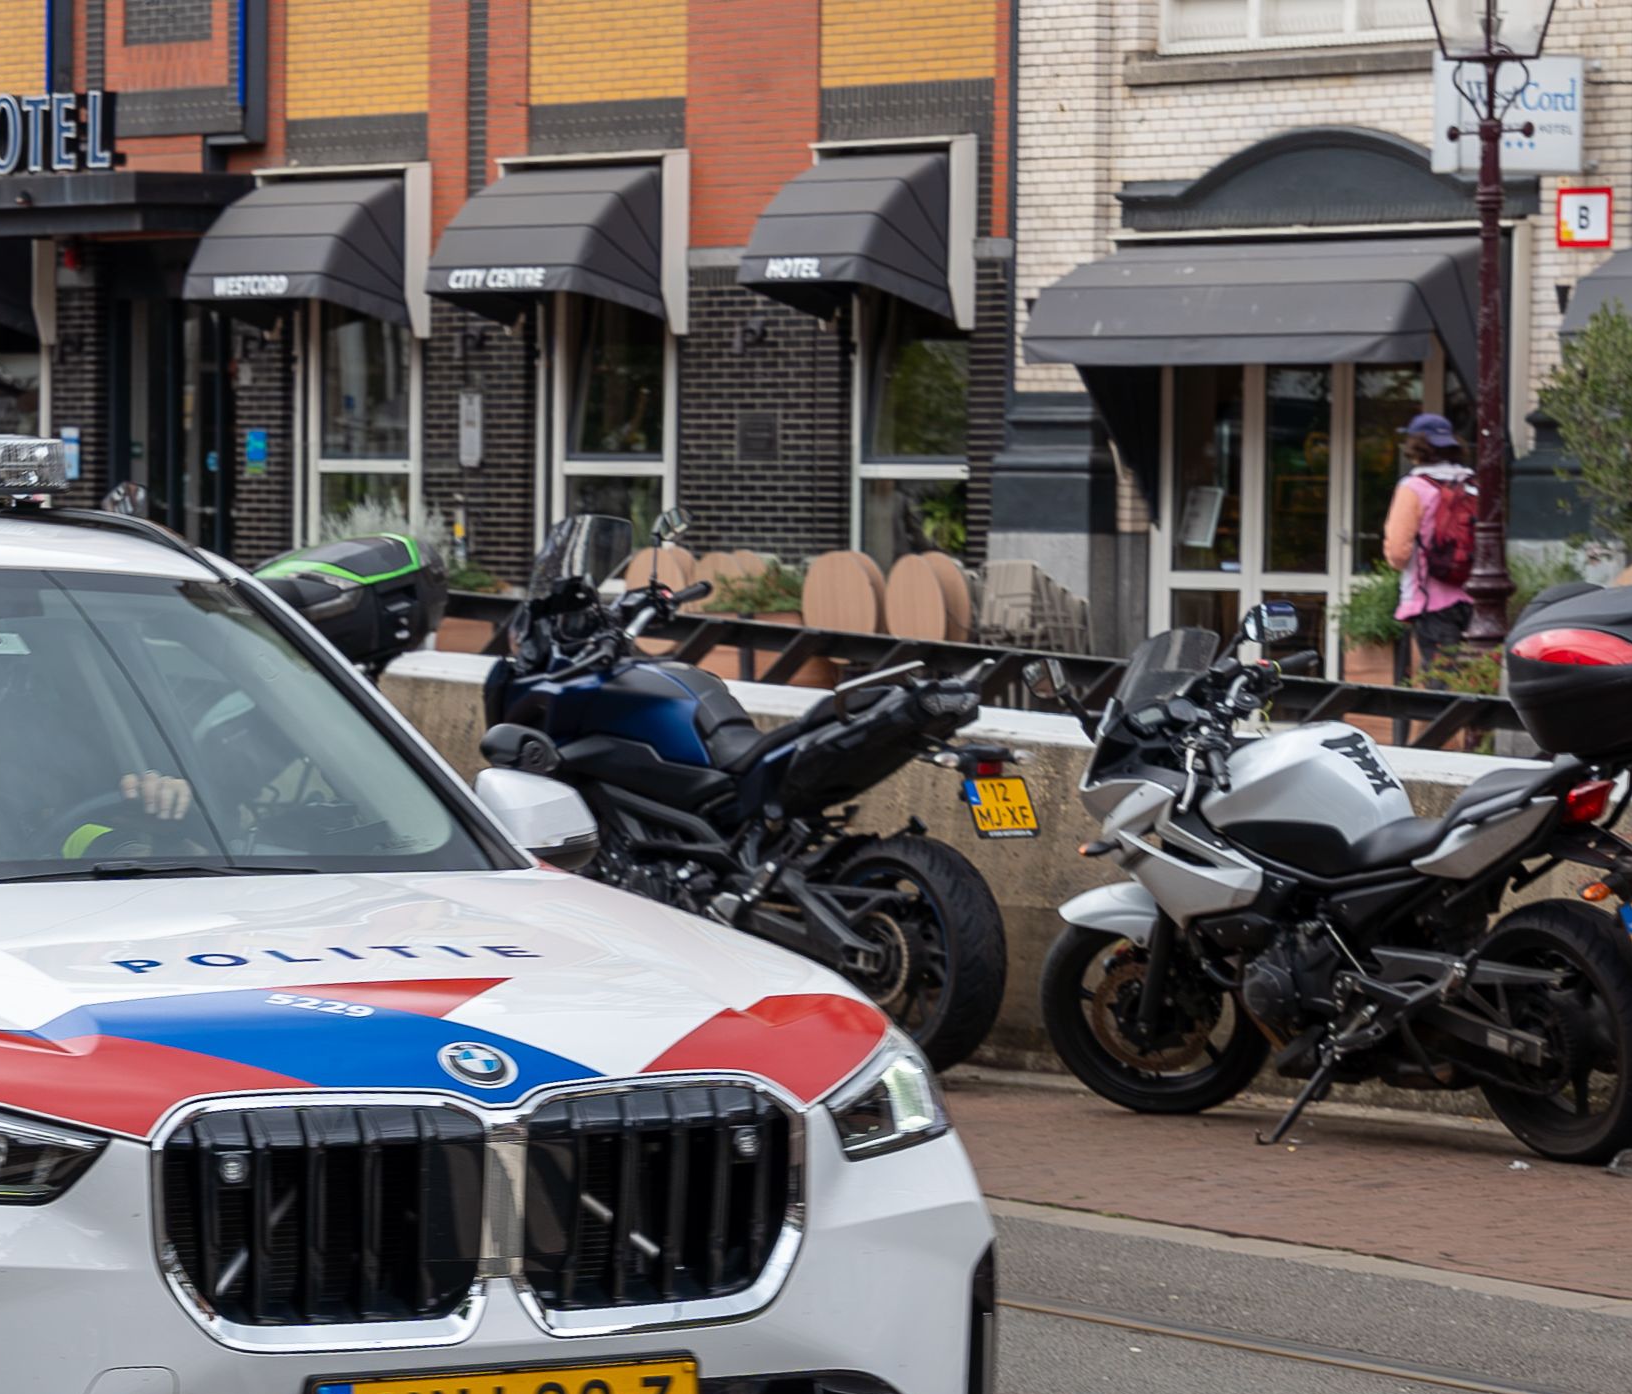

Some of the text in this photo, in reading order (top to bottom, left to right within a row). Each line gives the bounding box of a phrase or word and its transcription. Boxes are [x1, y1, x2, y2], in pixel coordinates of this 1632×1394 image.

[1578, 205, 1591, 230] B
[448, 267, 546, 290] CITY CENTRE
[764, 257, 822, 279] HOTEL
[213, 274, 289, 297] WESTCORD
[111, 944, 543, 974] POLITIE
[264, 992, 376, 1018] 5229
